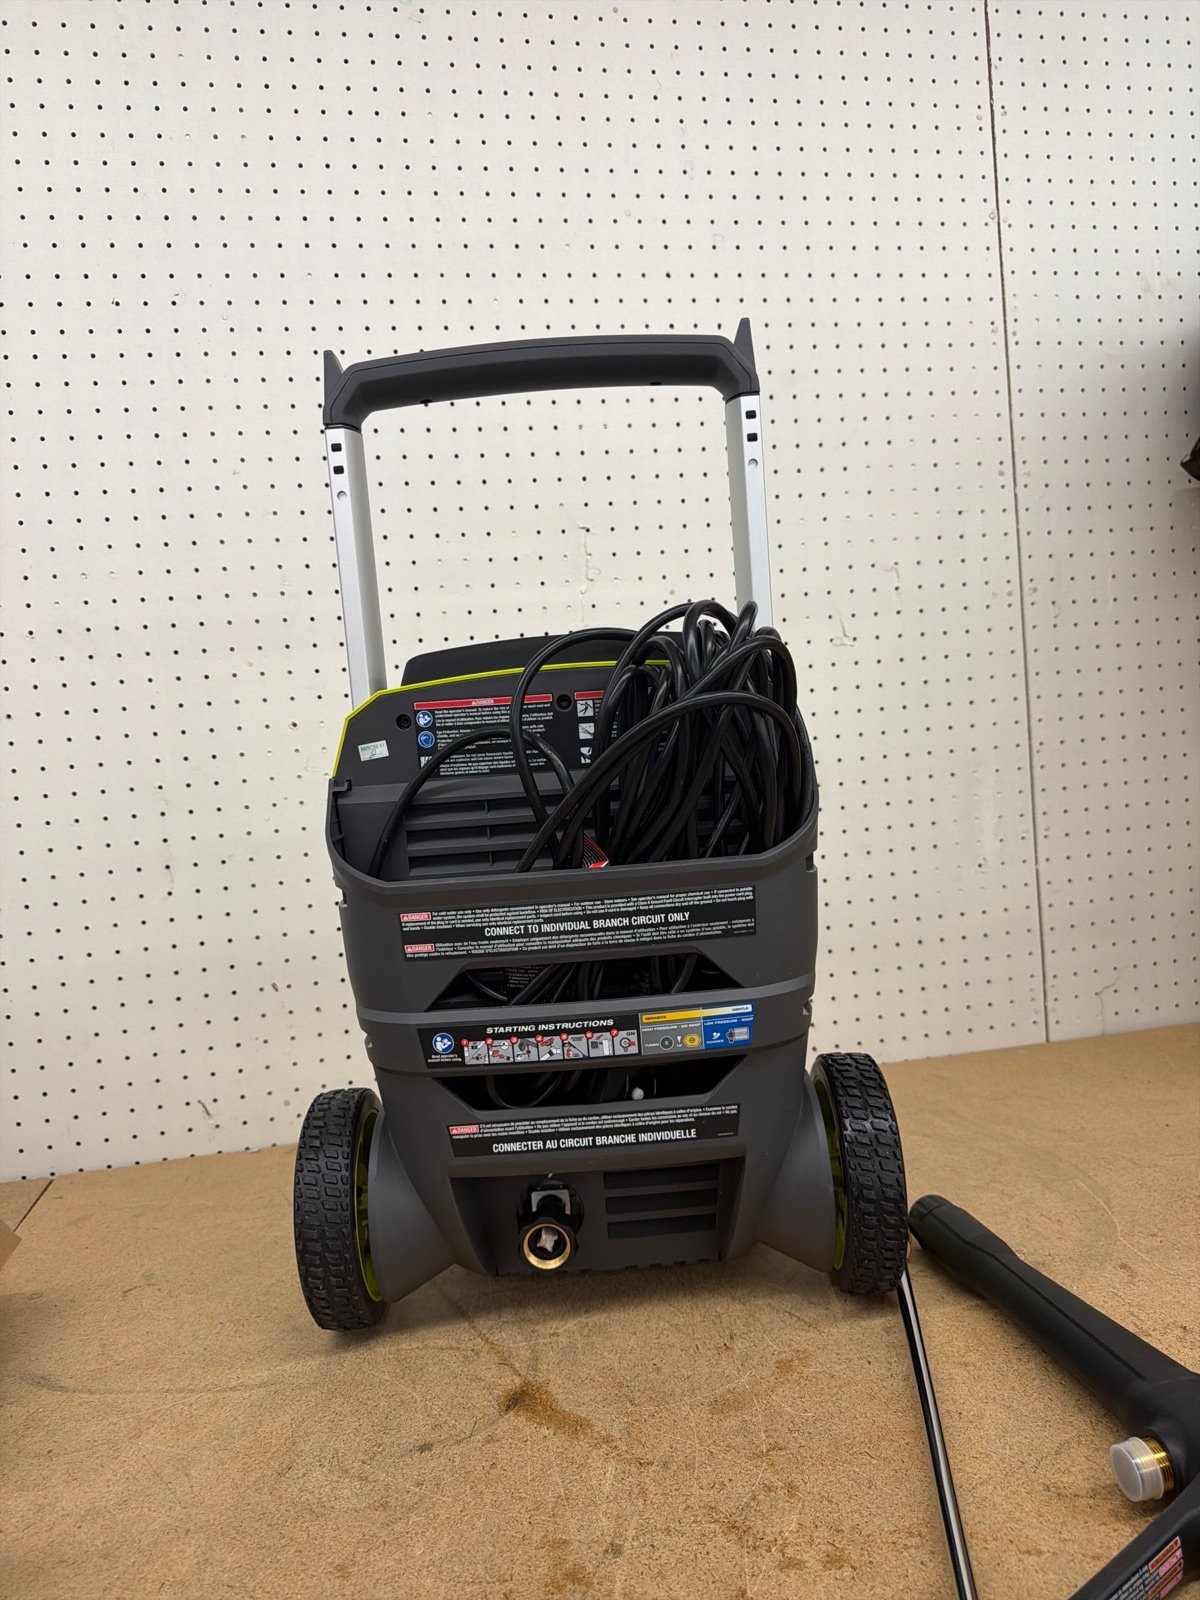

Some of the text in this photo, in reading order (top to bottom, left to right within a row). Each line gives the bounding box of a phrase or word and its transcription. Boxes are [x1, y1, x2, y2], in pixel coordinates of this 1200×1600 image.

[485, 912, 689, 936] CONNECT TO INDIVIDUAL BRANCH CIRCUIT ONLY
[486, 1019, 614, 1034] STARTING INSTRUCTIONS
[493, 1129, 696, 1152] CONNECTER AU CIRCUIT BRANCHE INDIVIDUELLE
